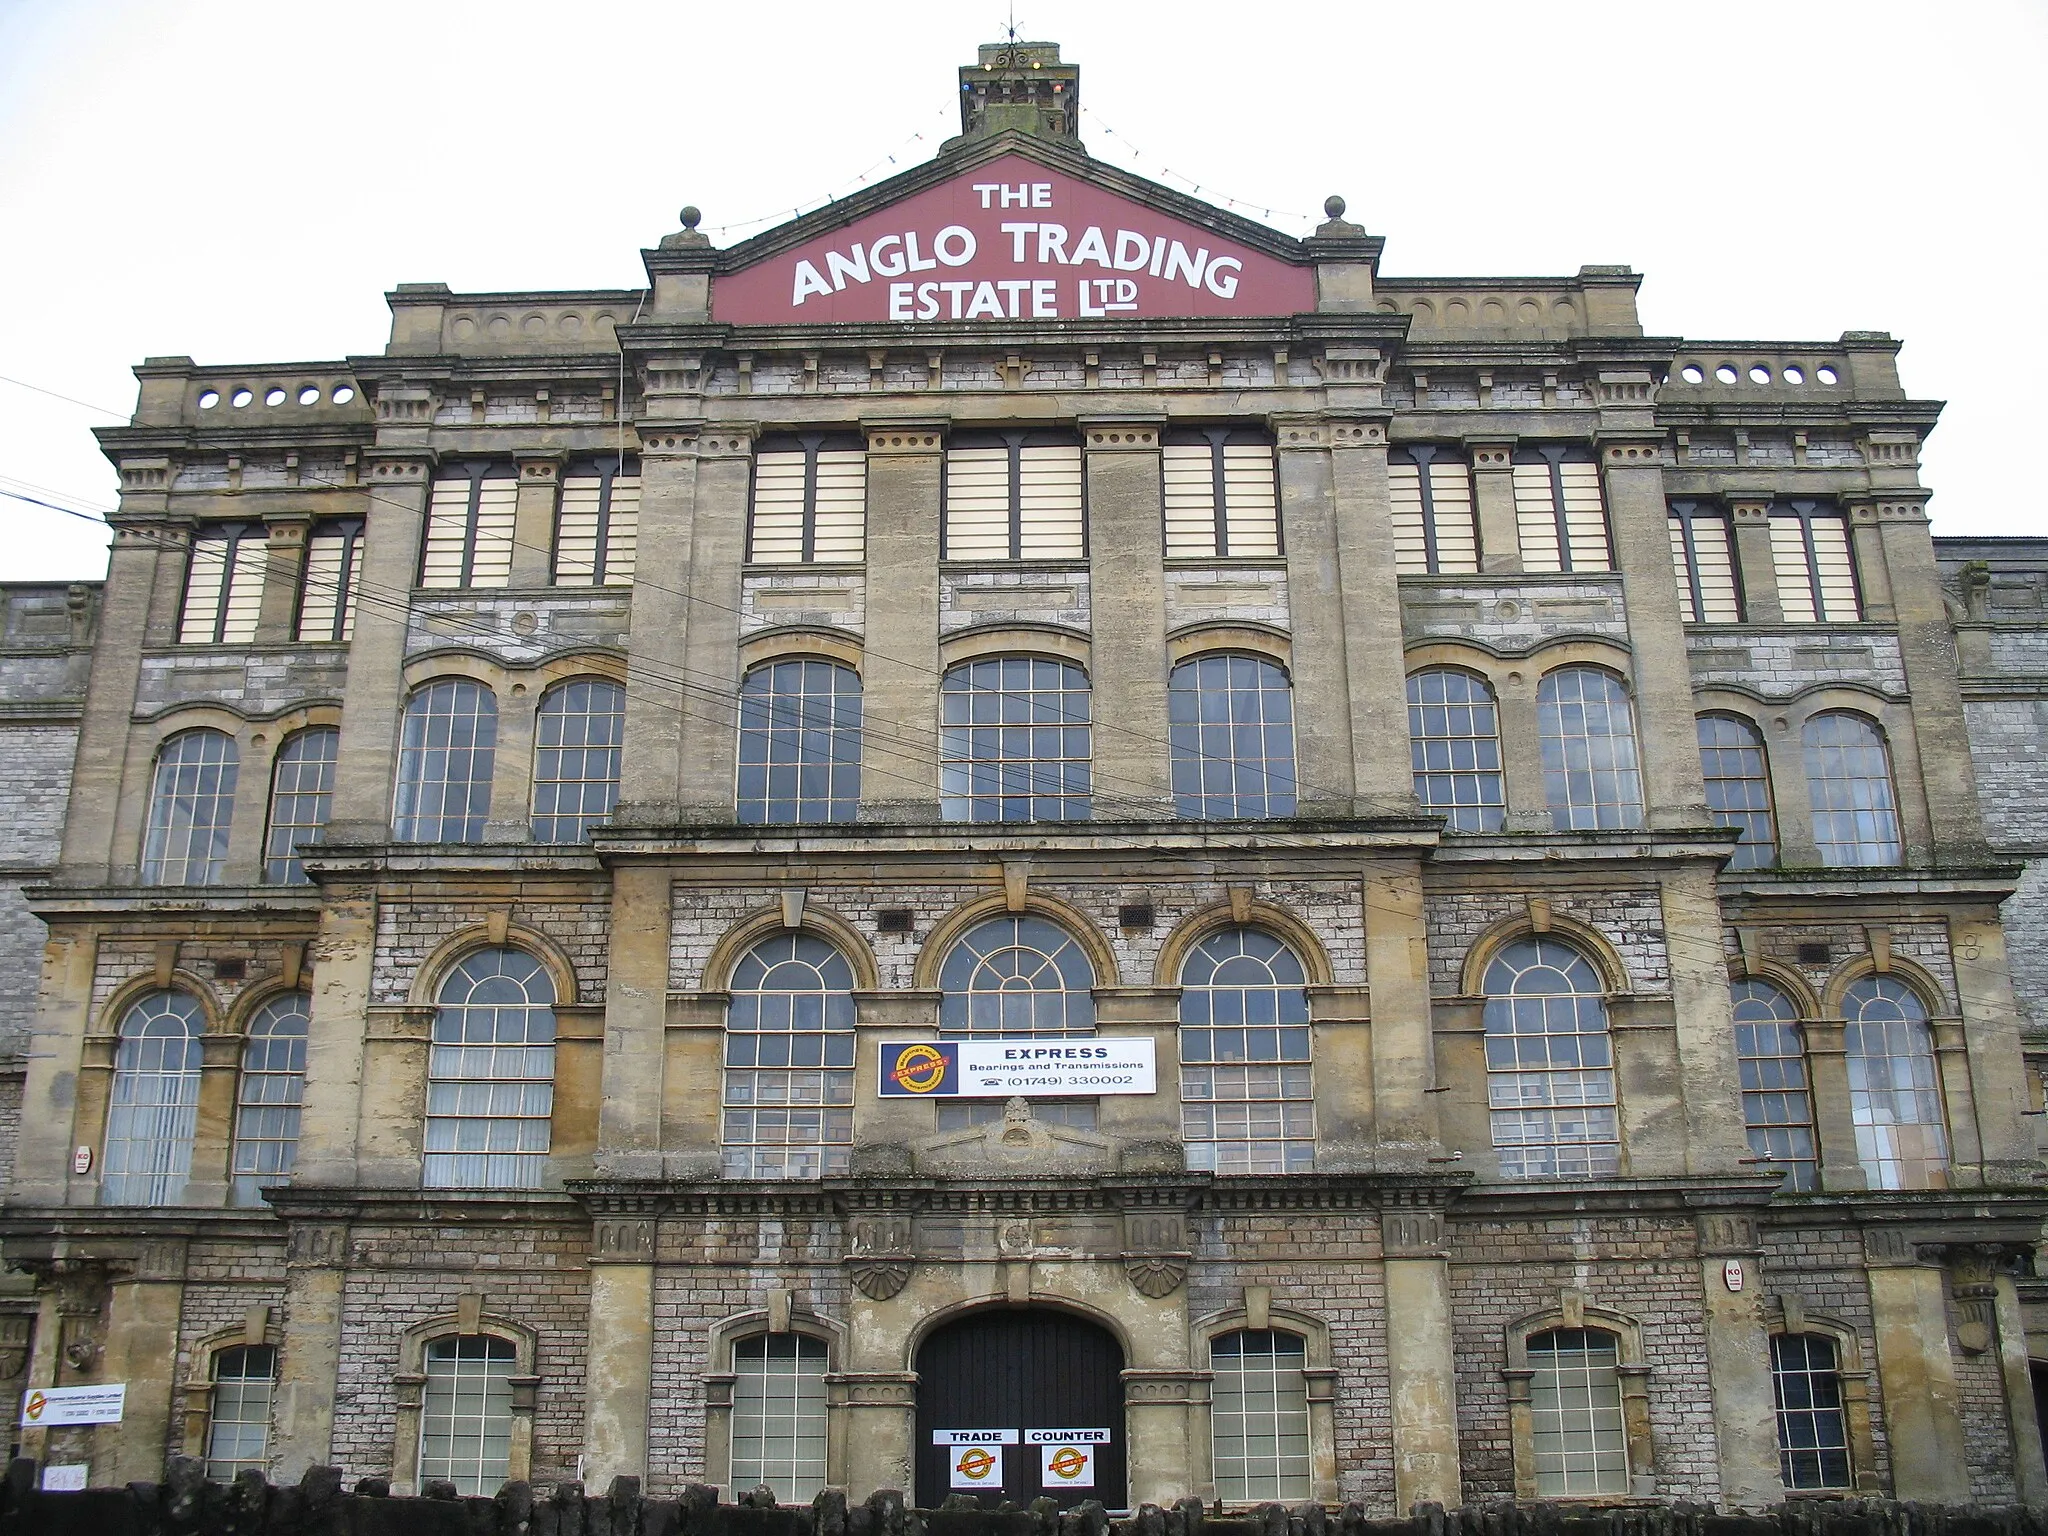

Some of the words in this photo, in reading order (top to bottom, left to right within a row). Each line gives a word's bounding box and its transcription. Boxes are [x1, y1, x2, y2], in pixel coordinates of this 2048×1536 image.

[972, 183, 1053, 209] THE
[792, 225, 977, 307] ANGLO
[1001, 222, 1243, 299] TRADING
[889, 279, 1058, 320] ESTATE
[1078, 278, 1138, 317] LTD
[1005, 1047, 1108, 1060] EXPRESS
[896, 1059, 943, 1077] EXPRESS
[969, 1063, 1025, 1072] Bearings
[1028, 1062, 1051, 1070] and
[1054, 1061, 1144, 1070] Transmissions
[1007, 1076, 1063, 1086] (01749)
[1068, 1075, 1133, 1085] 330002
[950, 1432, 1002, 1442] TRADE
[1031, 1431, 1104, 1441] COUNTER
